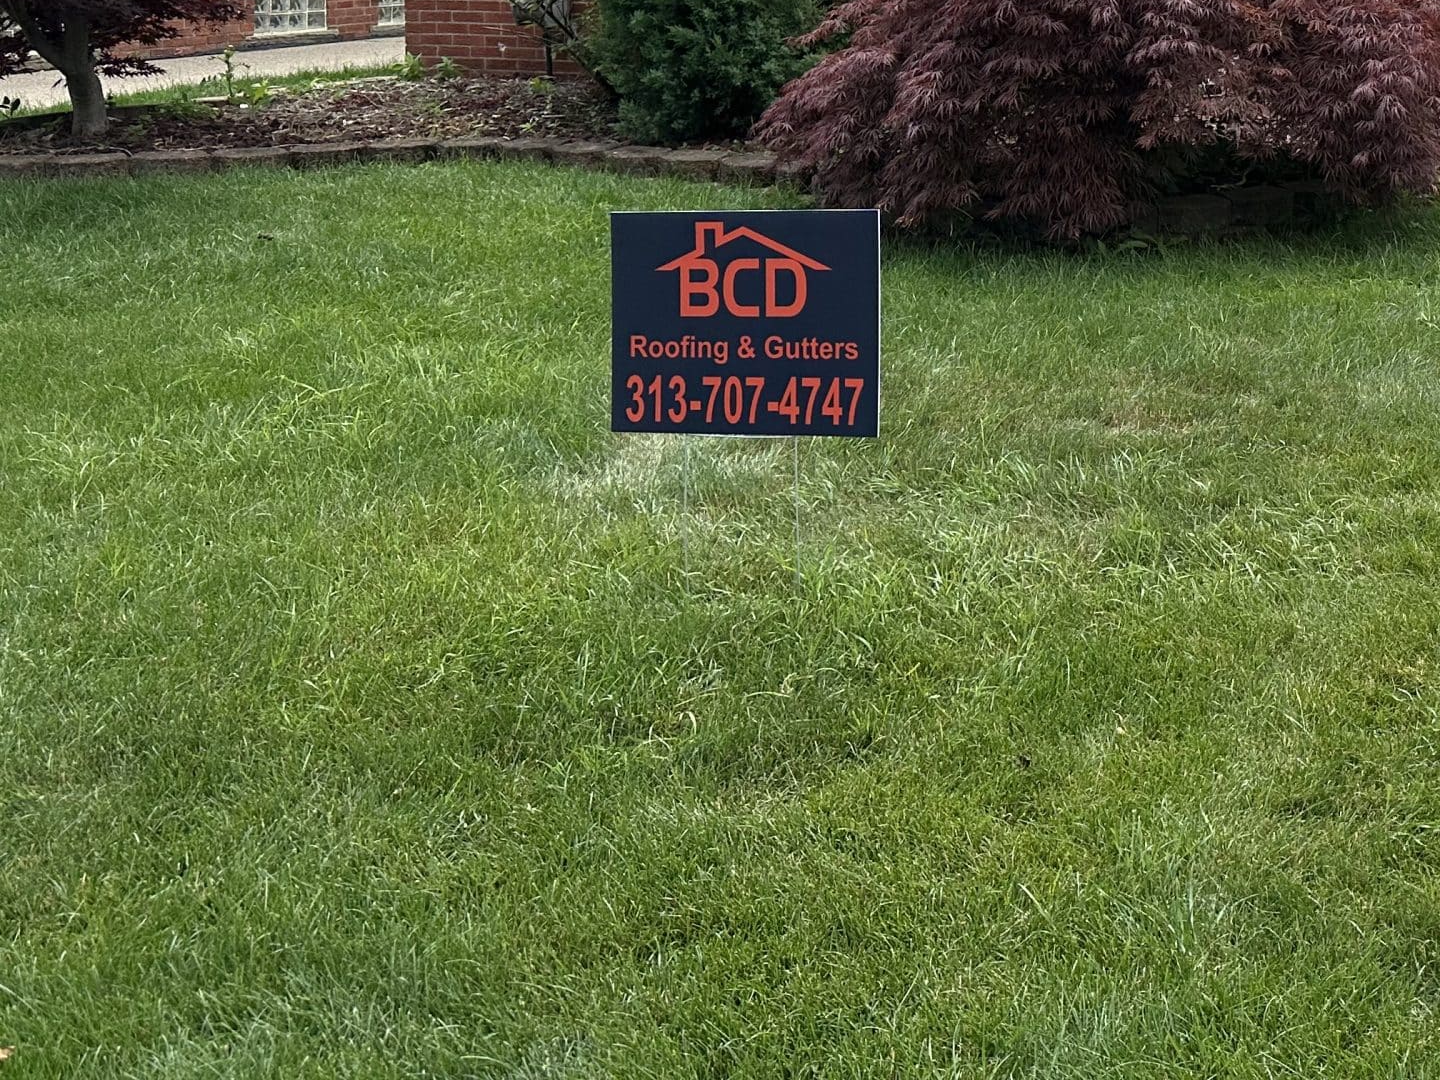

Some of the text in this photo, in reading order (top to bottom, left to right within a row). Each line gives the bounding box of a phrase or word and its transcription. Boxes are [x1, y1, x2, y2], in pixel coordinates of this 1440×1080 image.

[679, 258, 808, 318] BCD
[629, 335, 859, 365] Roofing & Gutters
[625, 374, 864, 426] 313-707-4747
